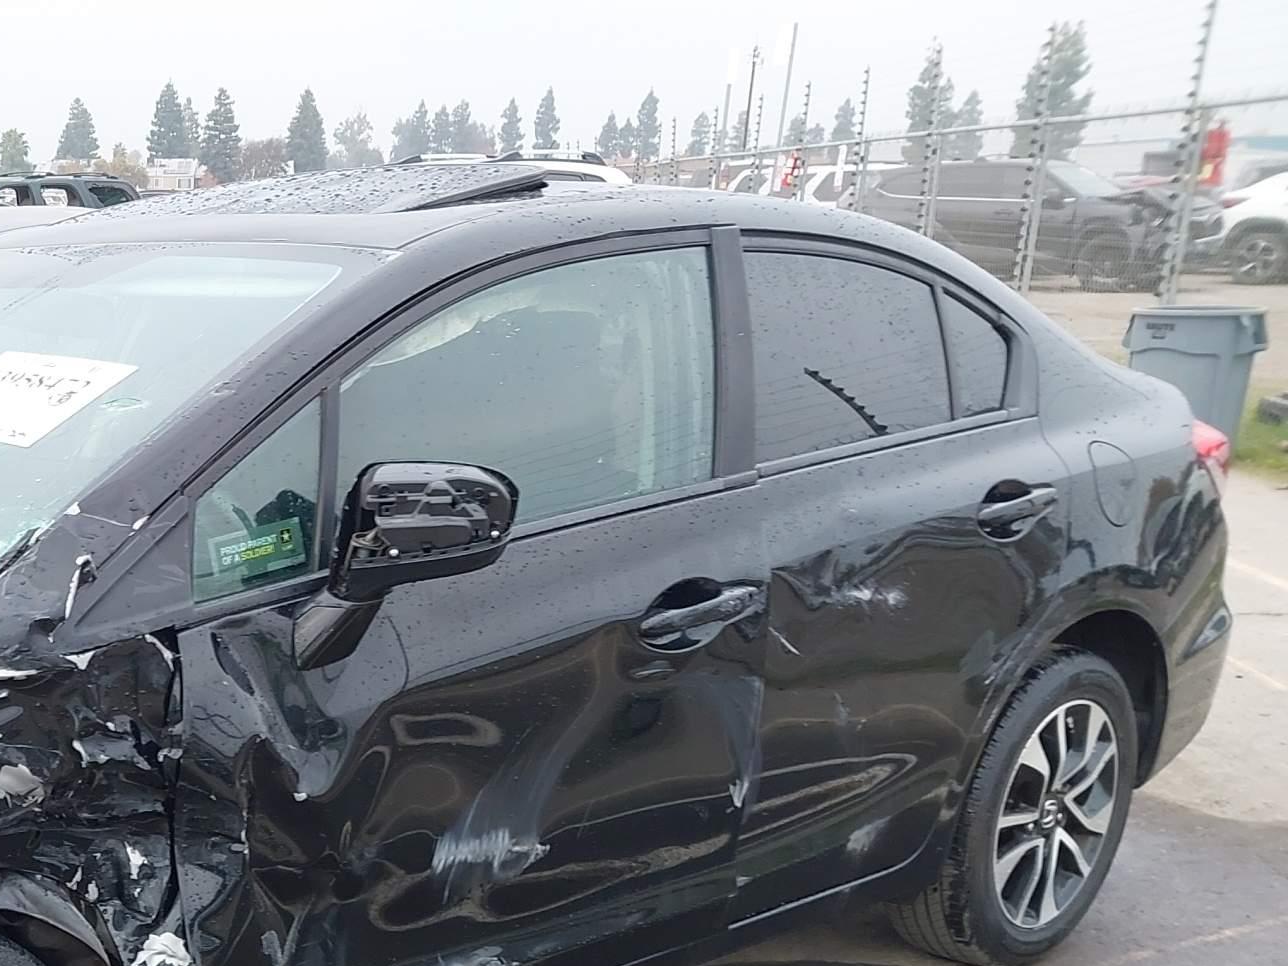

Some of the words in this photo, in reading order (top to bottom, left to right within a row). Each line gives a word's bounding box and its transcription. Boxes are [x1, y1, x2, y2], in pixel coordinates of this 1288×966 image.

[220, 541, 247, 557] PROUD
[247, 534, 278, 550] PARENT
[222, 555, 233, 566] OF
[234, 553, 242, 564] A
